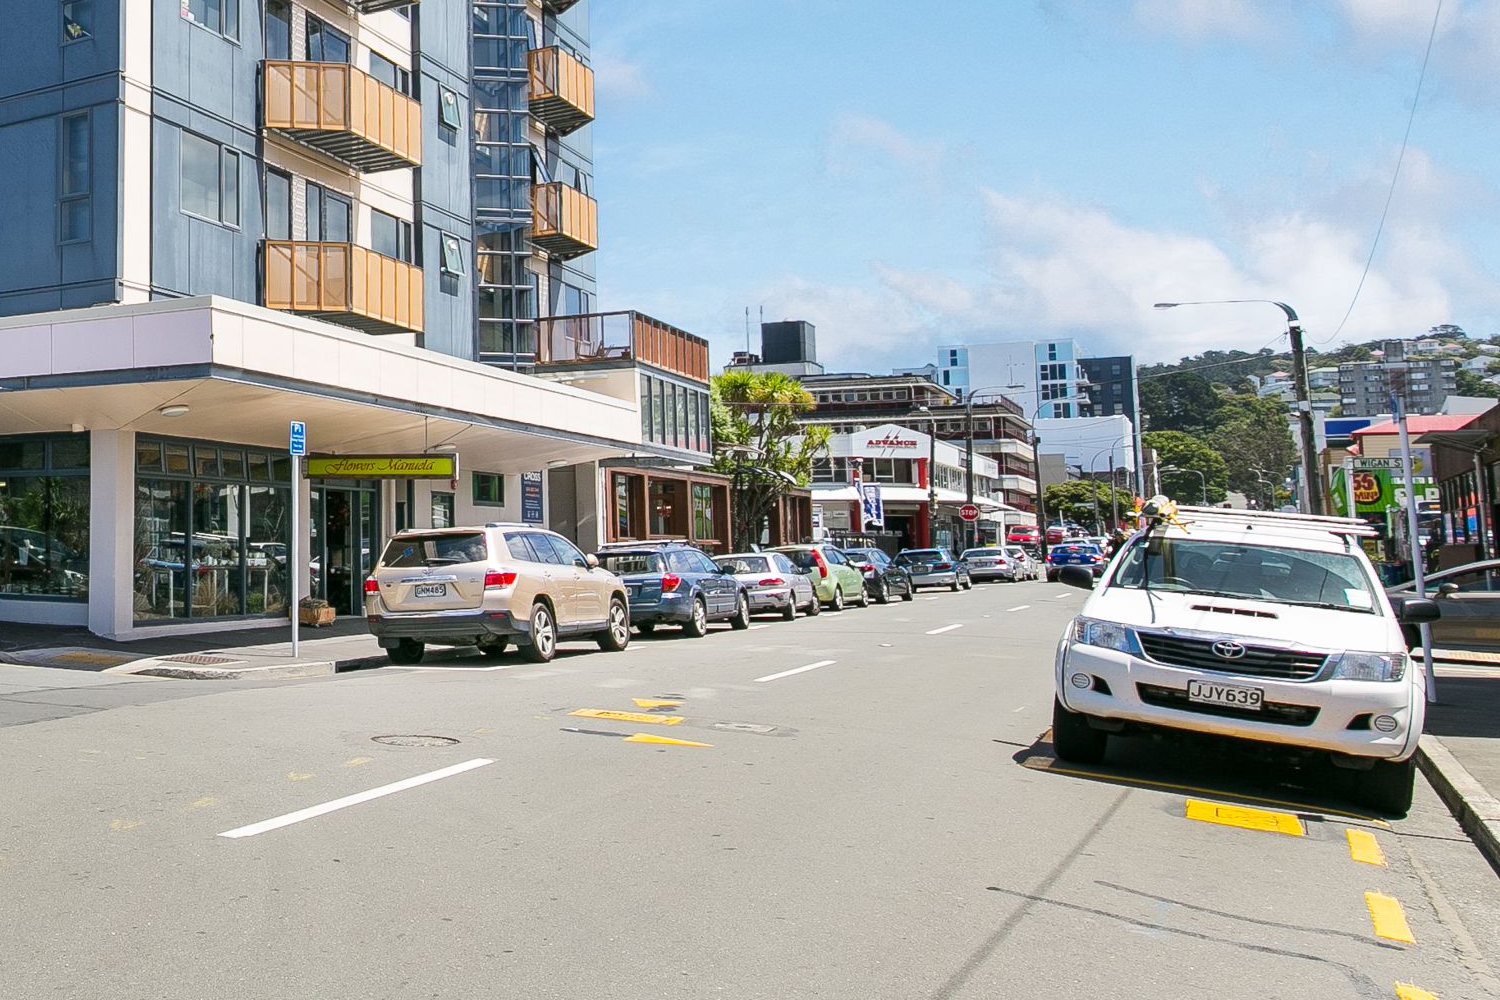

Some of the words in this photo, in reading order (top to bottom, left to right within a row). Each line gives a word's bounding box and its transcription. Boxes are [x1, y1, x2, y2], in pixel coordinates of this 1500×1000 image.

[325, 458, 375, 474] Flowers
[377, 458, 435, 471] Manuela
[1360, 459, 1390, 468] WIGAN
[523, 471, 541, 481] CROSS
[416, 584, 444, 595] GNM485
[1191, 685, 1260, 704] JJY639
